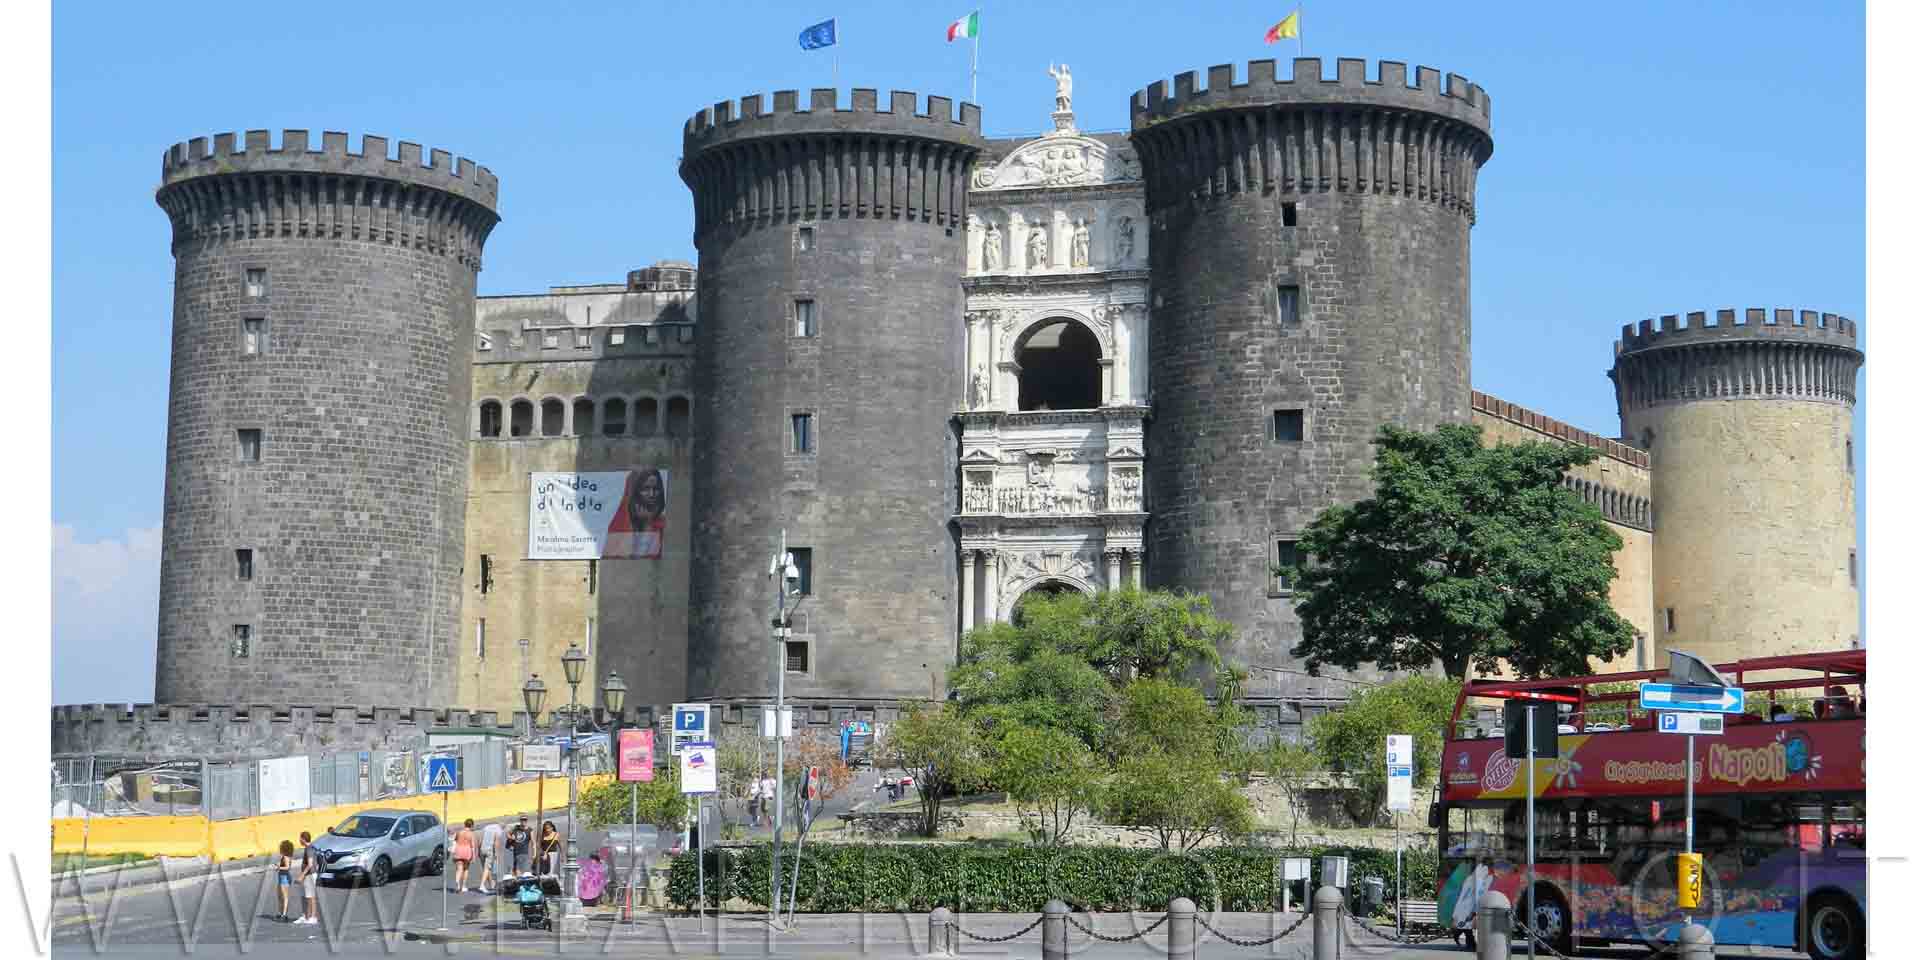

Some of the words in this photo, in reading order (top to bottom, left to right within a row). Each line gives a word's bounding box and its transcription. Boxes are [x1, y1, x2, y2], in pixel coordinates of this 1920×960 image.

[561, 496, 602, 512] India
[685, 713, 695, 729] P
[1664, 715, 1675, 729] P
[1709, 742, 1787, 787] Napoli
